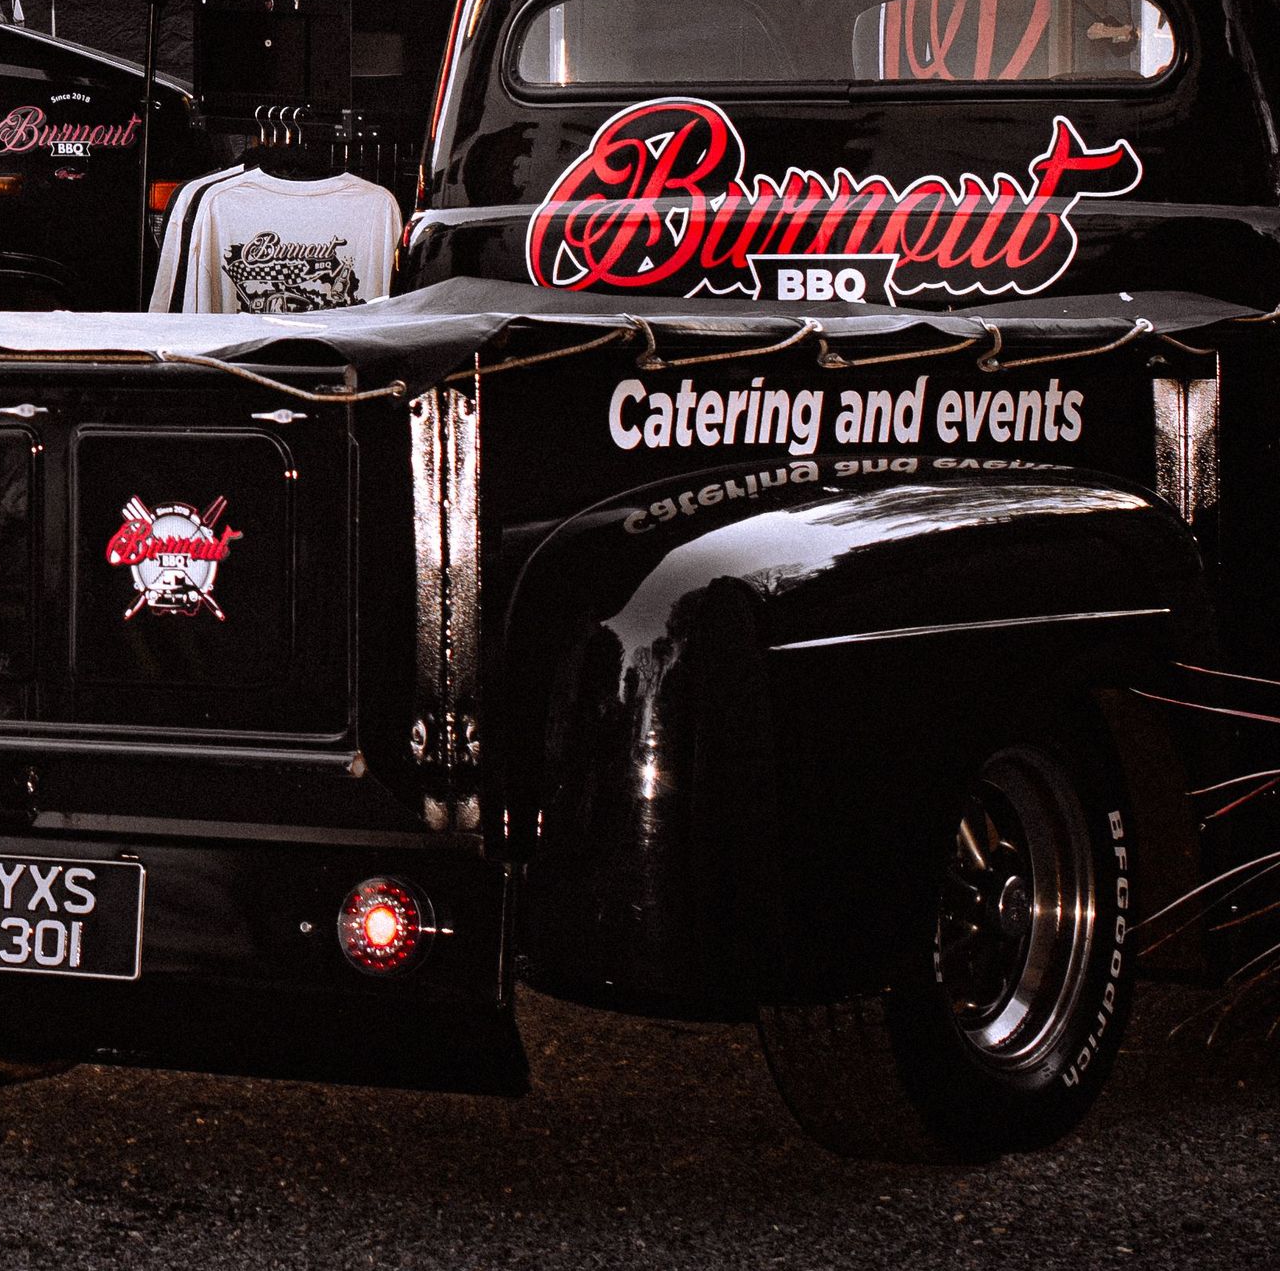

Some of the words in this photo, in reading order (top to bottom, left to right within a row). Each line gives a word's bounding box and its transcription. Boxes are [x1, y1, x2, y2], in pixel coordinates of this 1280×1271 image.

[50, 93, 71, 104] Since
[72, 92, 91, 104] 2018
[58, 143, 84, 156] BBQ
[528, 99, 1136, 294] Burnout
[241, 230, 348, 268] Burnout
[314, 261, 332, 269] BBQ
[777, 268, 866, 302] BBQ
[608, 376, 824, 456] Catering
[835, 375, 931, 443] and
[939, 378, 1084, 443] events
[161, 555, 186, 568] BBQ
[0, 917, 83, 968] 301
